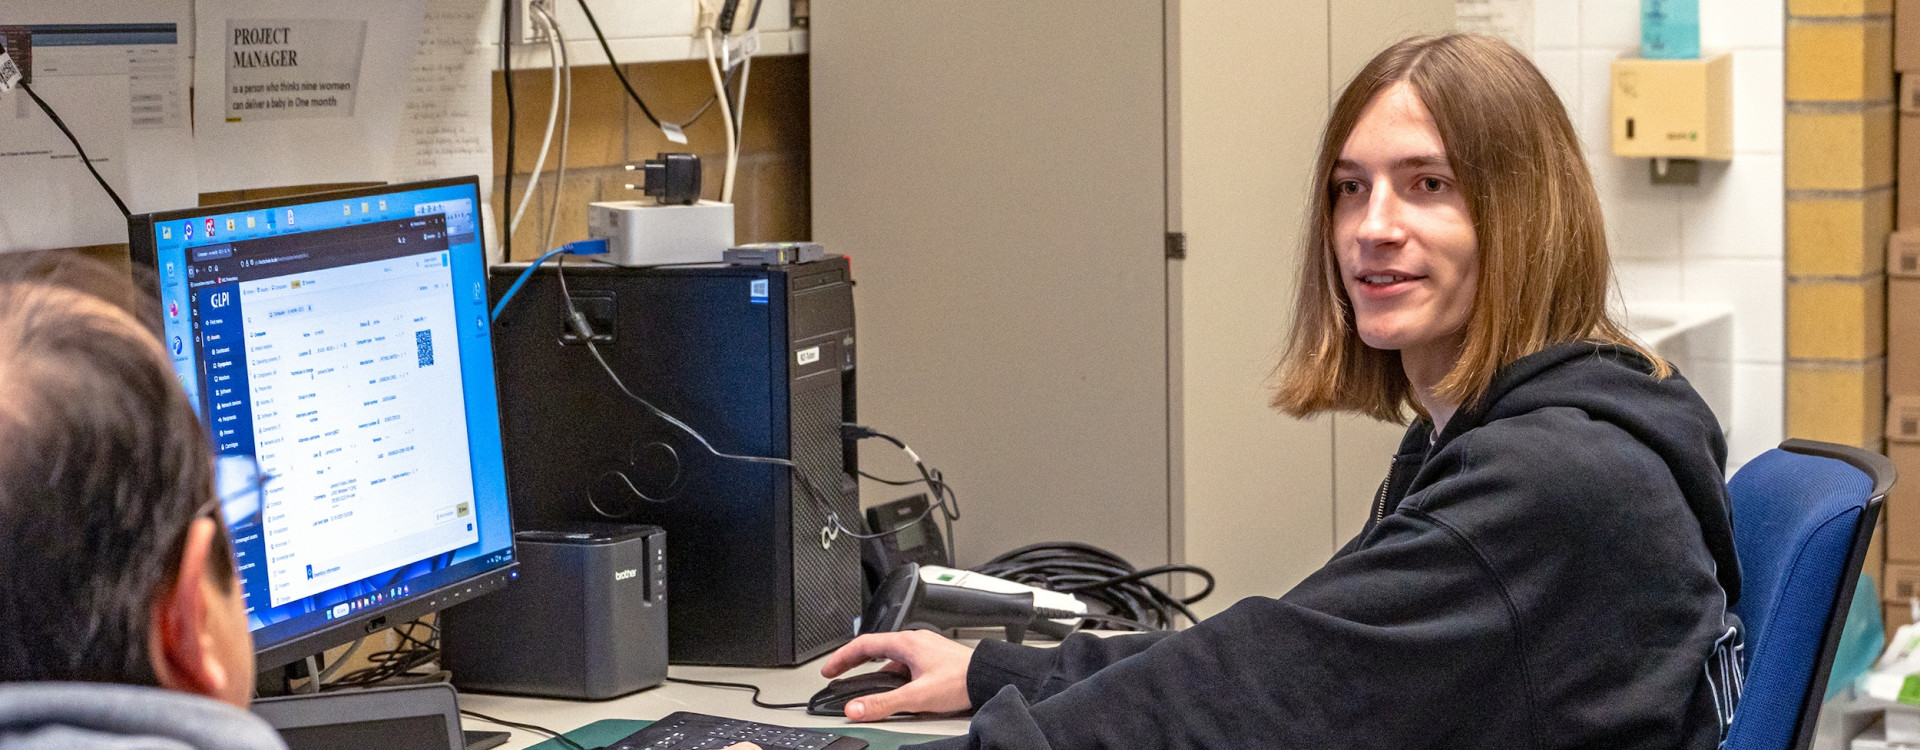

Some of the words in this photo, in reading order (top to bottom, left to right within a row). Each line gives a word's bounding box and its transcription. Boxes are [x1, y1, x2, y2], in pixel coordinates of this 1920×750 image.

[234, 28, 291, 45] PROJECT
[233, 50, 298, 68] MANAGER
[244, 85, 265, 94] person
[266, 83, 279, 92] who
[280, 82, 299, 91] thinks
[301, 83, 317, 91] nine
[319, 82, 350, 91] women
[233, 102, 243, 110] can
[245, 99, 265, 110] deliver
[271, 98, 286, 110] baby
[288, 98, 293, 107] in
[295, 97, 309, 107] One
[311, 96, 337, 106] month
[210, 291, 229, 309] GLPI
[615, 568, 637, 581] brother
